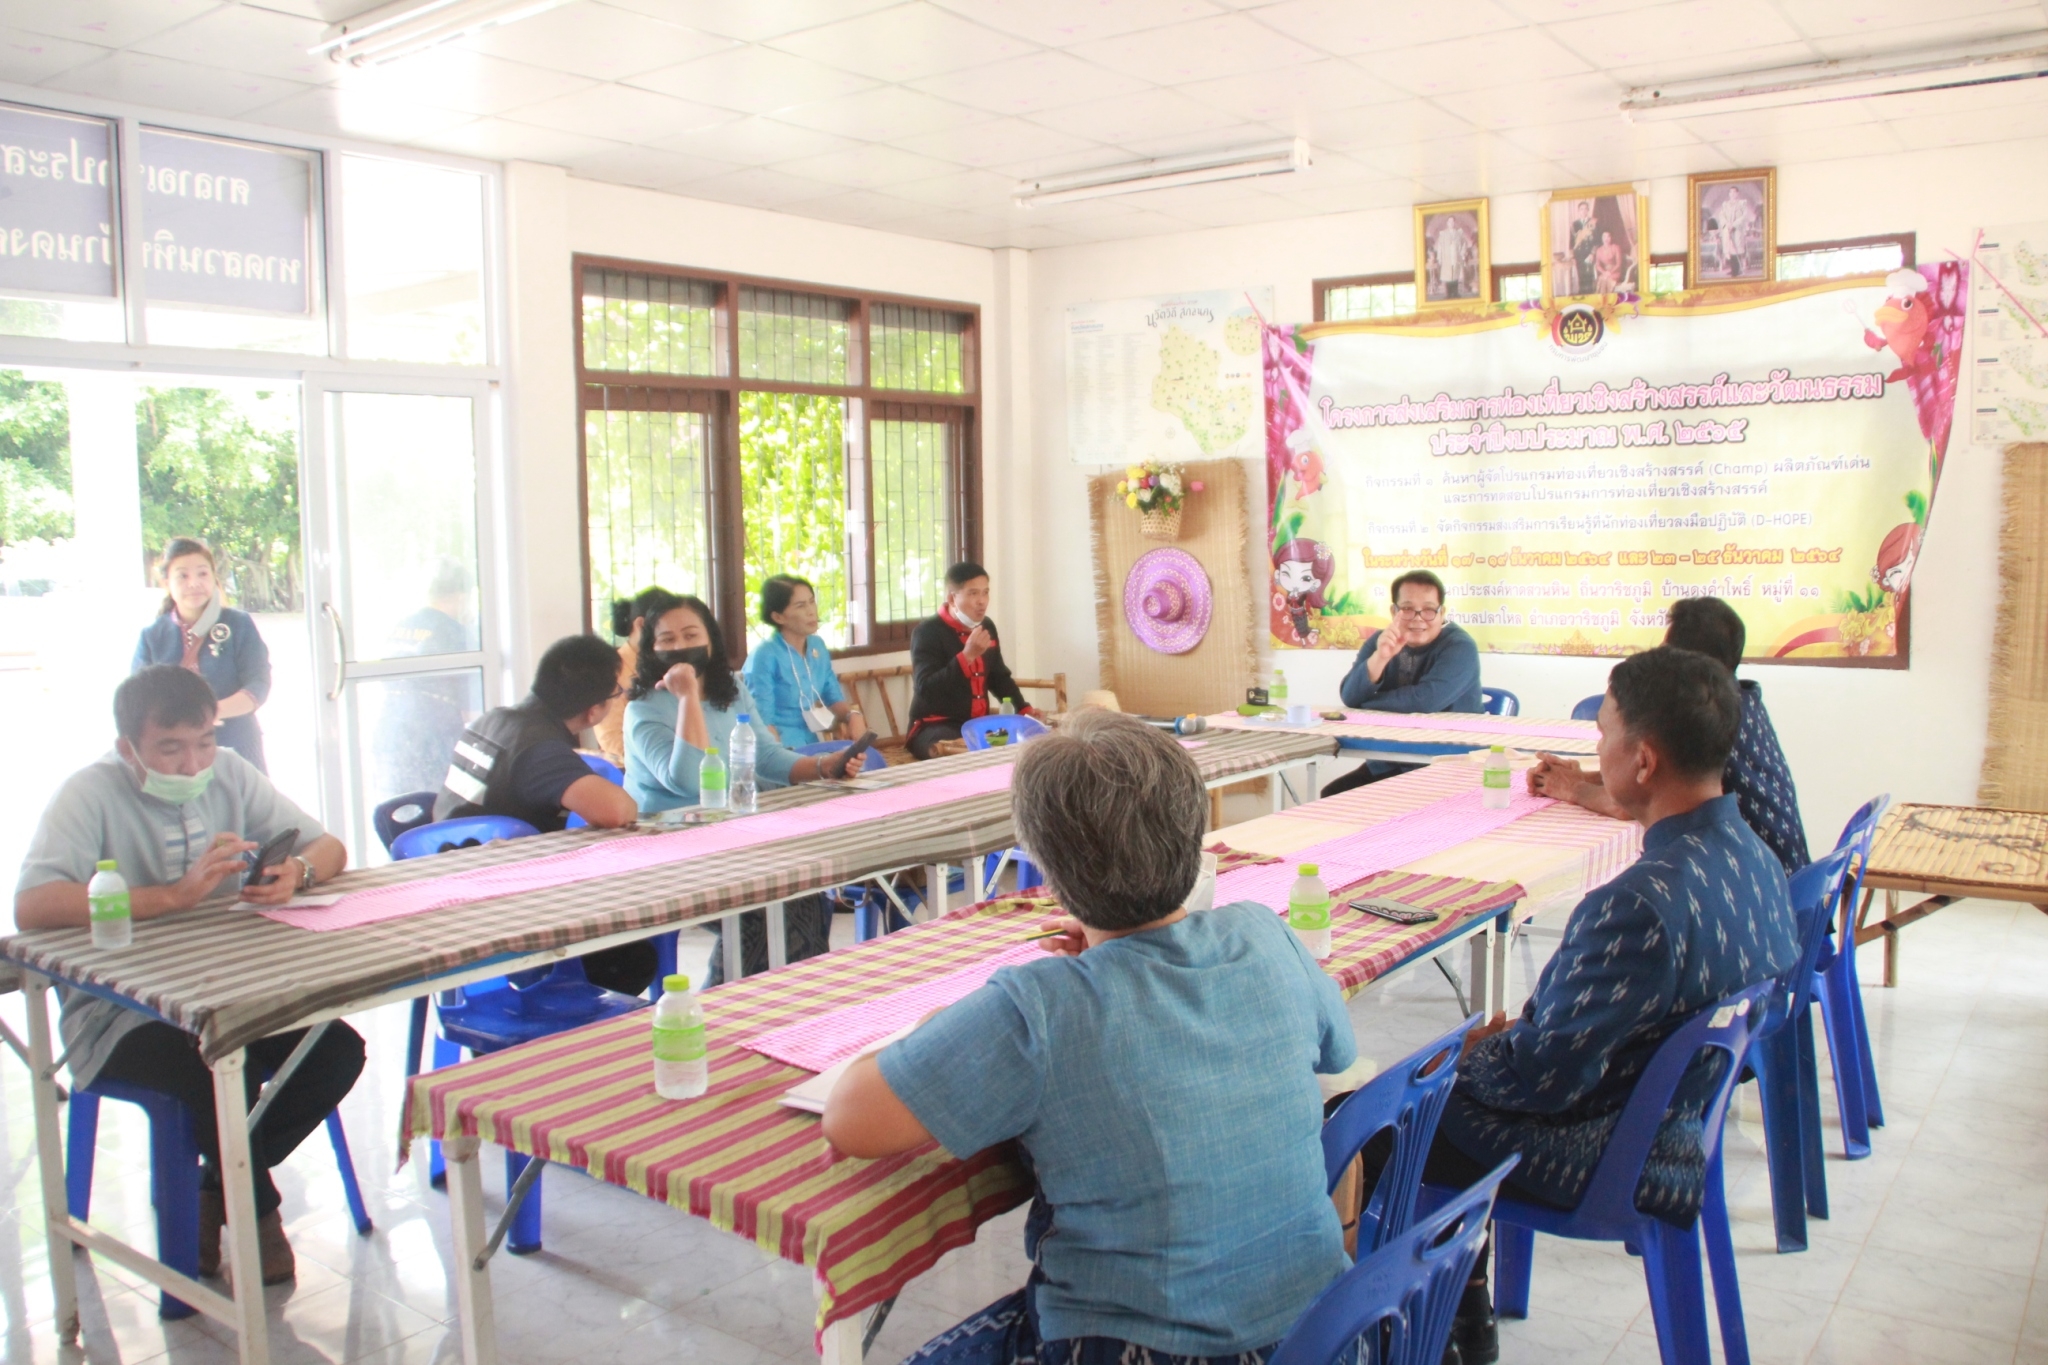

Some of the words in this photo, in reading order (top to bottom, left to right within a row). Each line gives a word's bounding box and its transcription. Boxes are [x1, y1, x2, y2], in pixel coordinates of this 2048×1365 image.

[1319, 368, 1885, 430] โครงการส่งเสริมการท่องเที่ยวเชิงสร้างสรรค์และวัฒนธรรม
[1430, 421, 1618, 456] ประจำปีงบประมาณ
[1621, 420, 1669, 448] พ.ศ.
[1673, 418, 1749, 445] ๒๕๖๕
[1365, 469, 1421, 488] กิจกรรมที่
[1708, 461, 1769, 477] (Champ)
[1773, 455, 1870, 473] ผลิตภัณฑ์เด่น
[1444, 479, 1768, 503] และการทดสอบโปรแกรมการท่องเที่ยวเชิงสร้างสรรค์
[1368, 517, 1416, 534] กิจกรรมที่
[1751, 512, 1812, 527] (D-HOPE)
[1361, 543, 1448, 568] ในระหว่างวันที่
[1510, 546, 1562, 567] ธันวาคม
[1564, 551, 1612, 567] ๒๕๖๔
[1618, 551, 1648, 566] และ
[1650, 549, 1677, 566] ๒๓
[1722, 543, 1783, 565] ธันวาคม
[1791, 547, 1843, 564] ๒๕๖๔
[1373, 585, 1385, 596] ณ
[1762, 576, 1793, 602] หมู่ที่
[1530, 609, 1620, 630] อำเภอวาริชภูมิ
[1629, 609, 1669, 626] จังหวั
